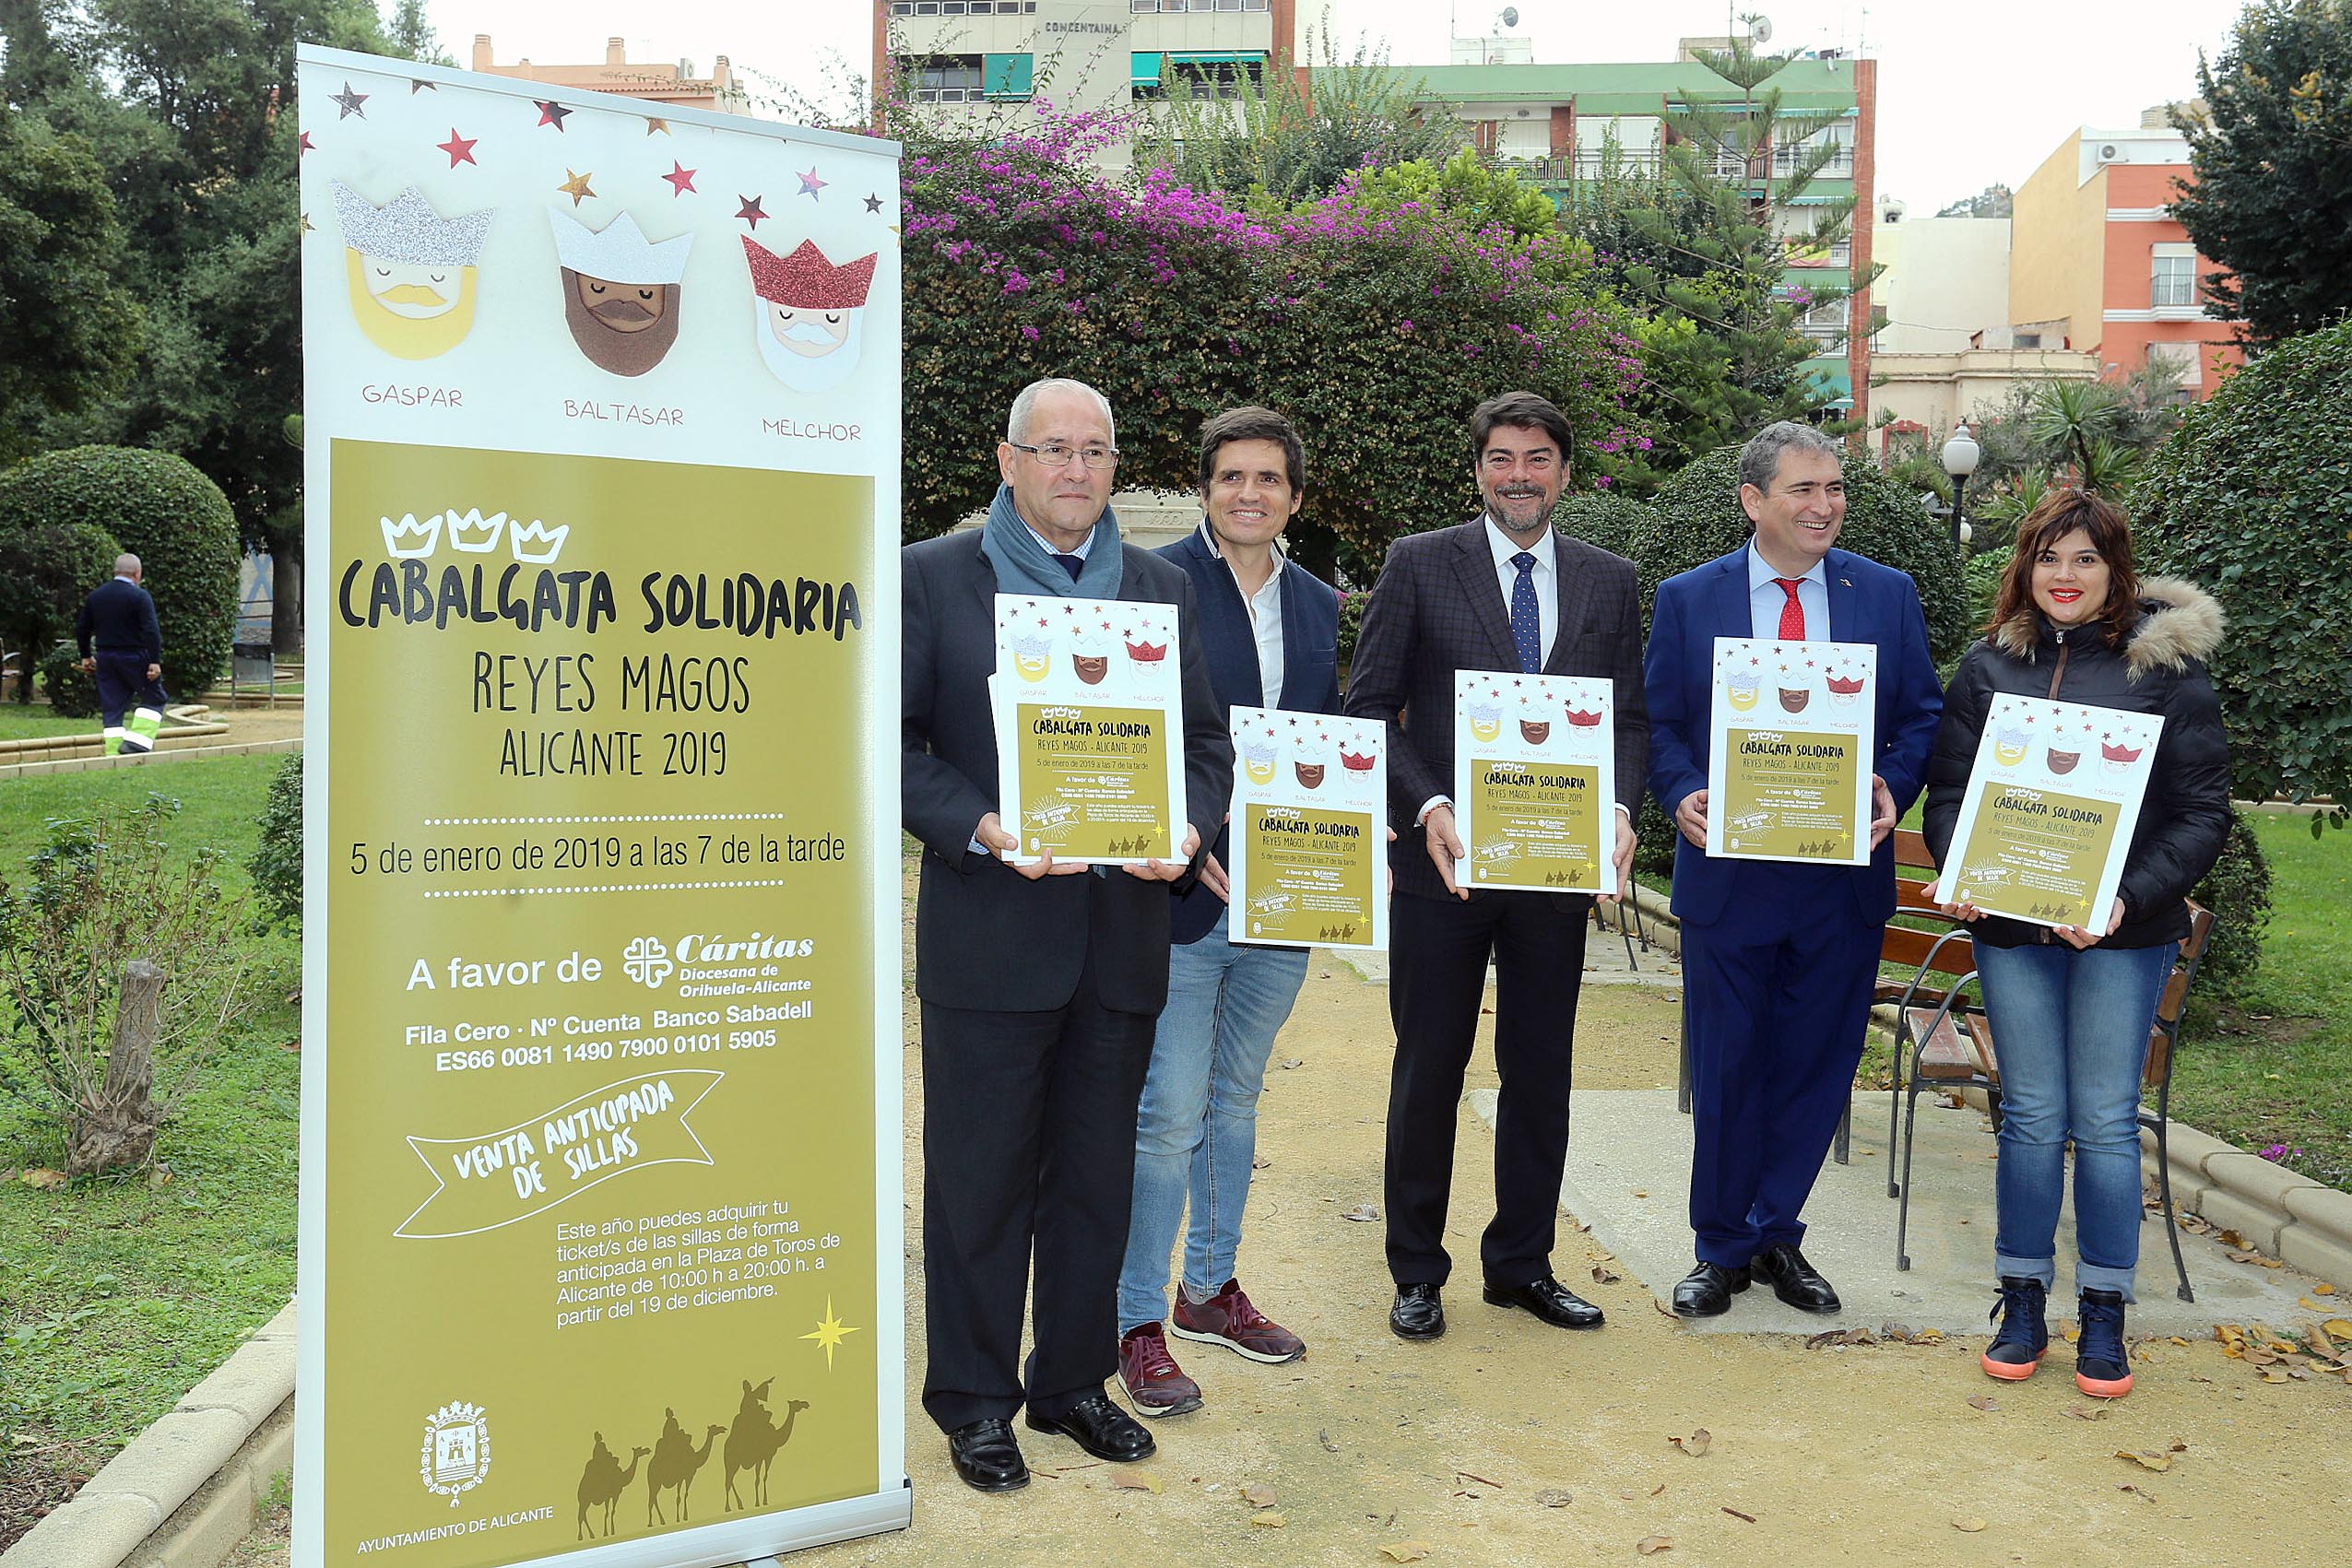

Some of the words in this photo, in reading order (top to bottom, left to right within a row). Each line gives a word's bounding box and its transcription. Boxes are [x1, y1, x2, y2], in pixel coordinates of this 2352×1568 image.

[360, 384, 464, 408] GASPAR
[563, 400, 684, 427] BALTASAR
[762, 418, 862, 442] MELCHOR
[338, 559, 617, 634] CABALGATA
[640, 571, 862, 642] SOLIDARIA
[473, 651, 596, 714] REYES
[621, 653, 750, 714] MAGOS
[1033, 719, 1093, 737] CABALGATA
[1098, 722, 1152, 738] SOLIDARIA
[499, 728, 643, 778] ALICANTE
[662, 730, 727, 777] 2019
[1037, 739, 1059, 751] REYES
[1063, 740, 1088, 752] MAGOS
[1096, 741, 1129, 753] ALICANTE
[1131, 742, 1148, 754] 2019
[1740, 742, 1791, 757] CABALGATA
[1797, 745, 1844, 760] SOLIDARIA
[1102, 760, 1111, 769] las
[1743, 758, 1762, 768] REYES
[1794, 760, 1823, 772] ALICANTE
[1826, 762, 1839, 772] 2019
[1484, 772, 1535, 787] CABALGATA
[1540, 775, 1586, 790] SOLIDARIA
[1488, 788, 1507, 798] REYES
[1509, 789, 1531, 800] MAGOS
[1538, 791, 1566, 802] ALICANTE
[1568, 793, 1582, 803] 2019
[1993, 796, 2048, 816] CABALGATA
[2052, 805, 2102, 826] SOLIDARIA
[1993, 812, 2015, 824] REYES
[2015, 816, 2039, 828] MAGOS
[2045, 820, 2076, 834] ALICANTE
[2078, 827, 2095, 838] 2019
[1259, 818, 1310, 835] CABALGATA
[1315, 822, 1360, 839] SOLIDARIA
[1263, 835, 1282, 846] REYES
[1284, 837, 1306, 848] MAGOS
[1313, 839, 1340, 851] ALICANTE
[1343, 842, 1356, 852] 2019
[350, 843, 368, 875] 5
[379, 841, 412, 874] de
[423, 846, 501, 872] enero
[513, 839, 544, 870] de
[553, 837, 621, 868] 2019
[630, 842, 644, 867] a
[653, 835, 688, 866] las
[697, 835, 712, 865] 7
[721, 834, 751, 864] de
[760, 833, 780, 863] la
[786, 831, 845, 862] tarde
[675, 931, 813, 964] Cáritas
[406, 958, 436, 991] A
[447, 957, 546, 989] favor
[556, 951, 603, 984] de
[679, 965, 756, 982] Diocesana
[761, 963, 779, 978] de
[679, 978, 811, 998] Orihuela-Alicante
[405, 1025, 447, 1045] Fila
[454, 1023, 510, 1043] Cero
[562, 1013, 642, 1036] Cuenta
[653, 1009, 720, 1029] Banco
[725, 1000, 812, 1024] Sabadell
[435, 1051, 496, 1072] ES66
[501, 1045, 552, 1067] 0081
[561, 1041, 613, 1063] 1490
[619, 1036, 668, 1059] 7900
[673, 1032, 722, 1055] 0101
[727, 1029, 776, 1050] 5905
[452, 1131, 535, 1180] VENTA
[543, 1079, 675, 1155] ANTICIPADA
[512, 1161, 547, 1199] DE
[563, 1126, 639, 1180] SILLAS
[557, 1222, 597, 1242] Este
[601, 1218, 633, 1236] año
[639, 1209, 702, 1234] puedes
[706, 1201, 769, 1222] adquirir
[772, 1199, 789, 1215] tu
[556, 1239, 621, 1262] ticket/s
[626, 1234, 648, 1253] de
[653, 1232, 677, 1250] las
[681, 1228, 722, 1246] sillas
[727, 1223, 748, 1240] de
[751, 1218, 800, 1238] forma
[556, 1256, 646, 1284] anticipada
[651, 1255, 672, 1271] en
[678, 1250, 692, 1267] la
[697, 1246, 742, 1265] Plaza
[746, 1241, 768, 1259] de
[772, 1235, 816, 1256] Toros
[820, 1232, 841, 1249] de
[556, 1281, 626, 1305] Alicante
[631, 1276, 654, 1294] de
[660, 1269, 708, 1290] 10:00
[712, 1267, 723, 1284] h
[727, 1268, 739, 1282] a
[743, 1258, 791, 1279] 20:00
[796, 1256, 810, 1273] h.
[814, 1256, 825, 1270] a
[556, 1304, 604, 1330] partir
[608, 1300, 633, 1320] del
[640, 1296, 661, 1315] 19
[666, 1292, 688, 1310] de
[692, 1282, 779, 1308] diciembre.
[357, 1522, 466, 1554] AYUNTAMIENTO
[468, 1518, 487, 1533] DE
[490, 1505, 554, 1529] ALICANTE
